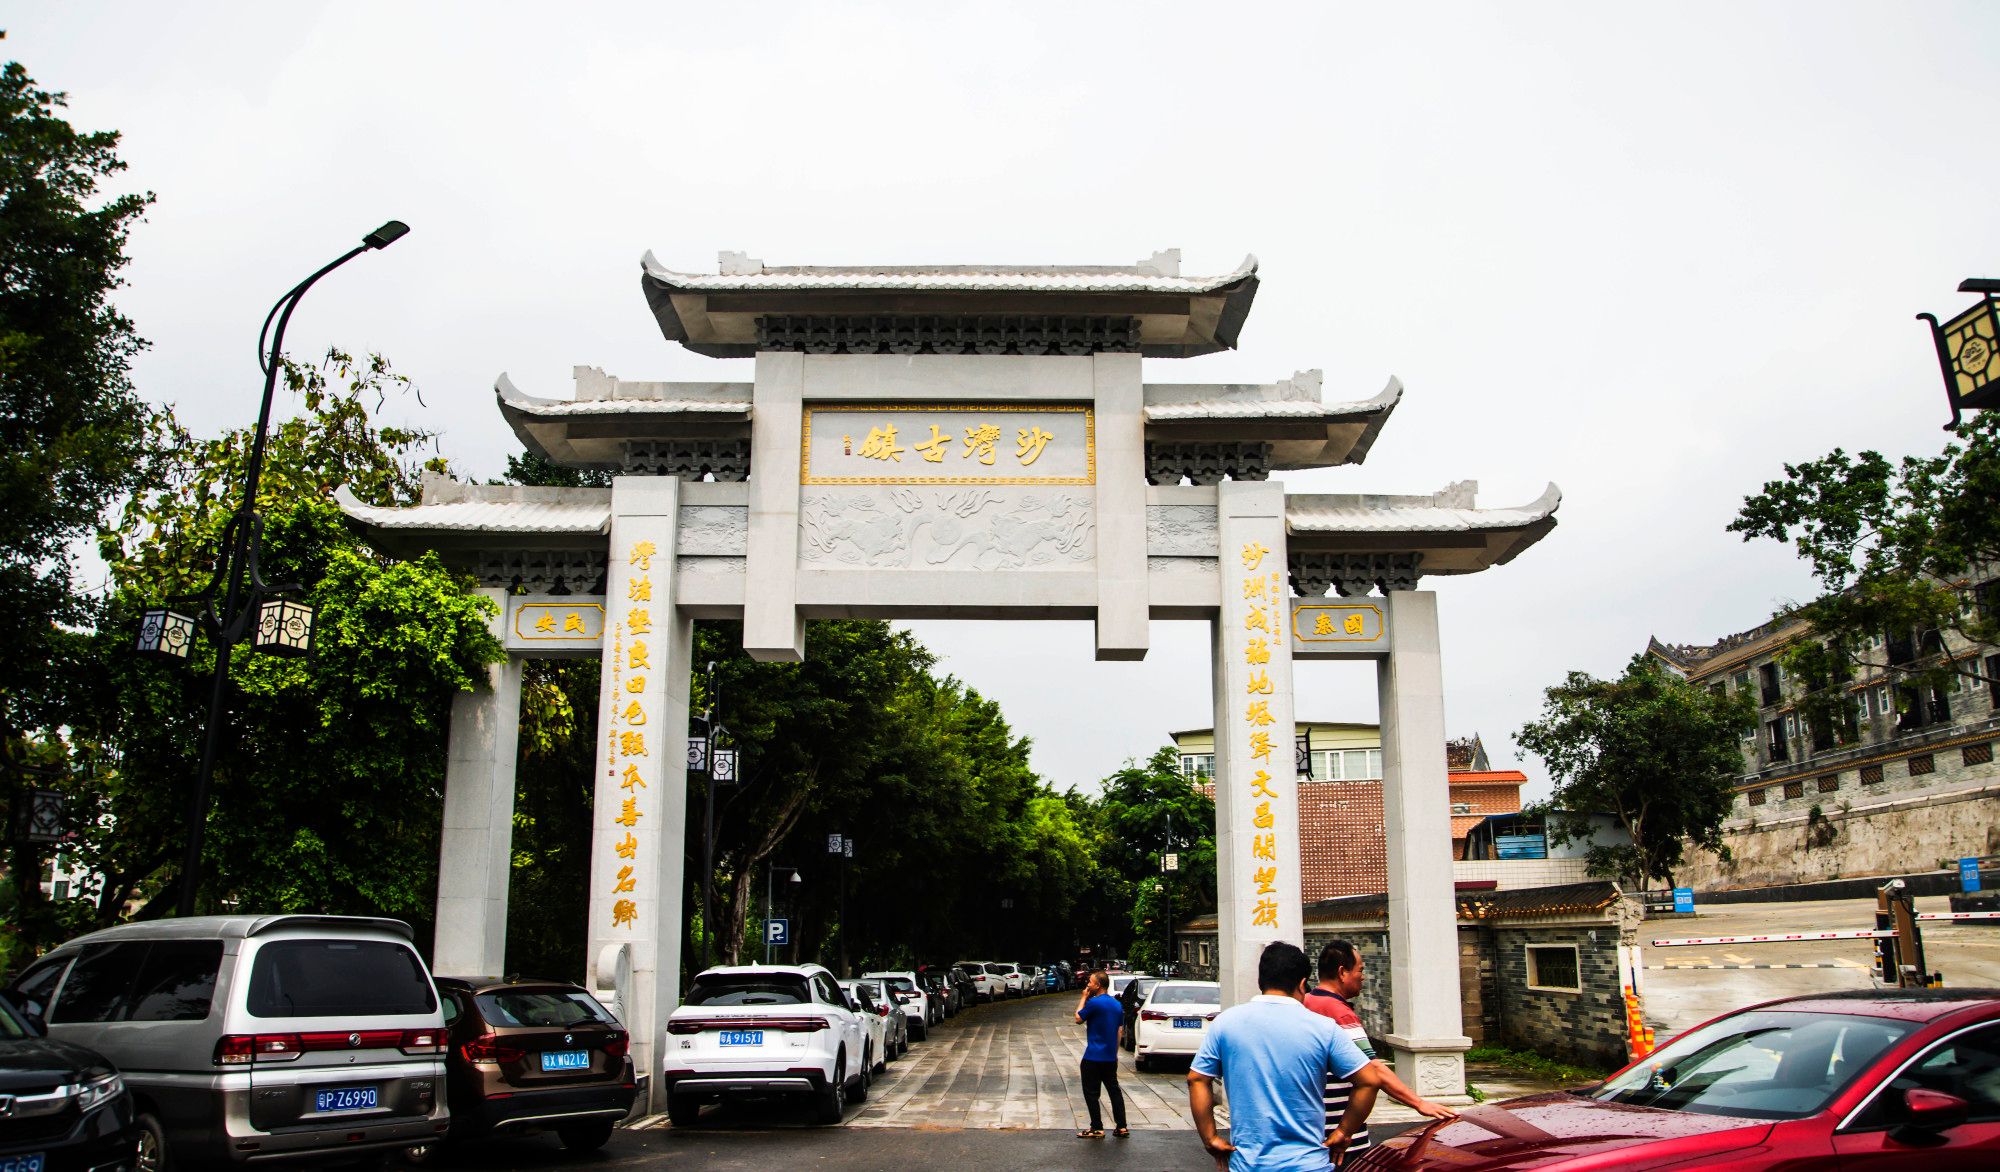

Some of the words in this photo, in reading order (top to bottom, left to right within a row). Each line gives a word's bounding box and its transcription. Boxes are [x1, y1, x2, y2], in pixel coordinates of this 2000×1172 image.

[857, 424, 1053, 466] 沙灣古鎮
[768, 923, 784, 941] P
